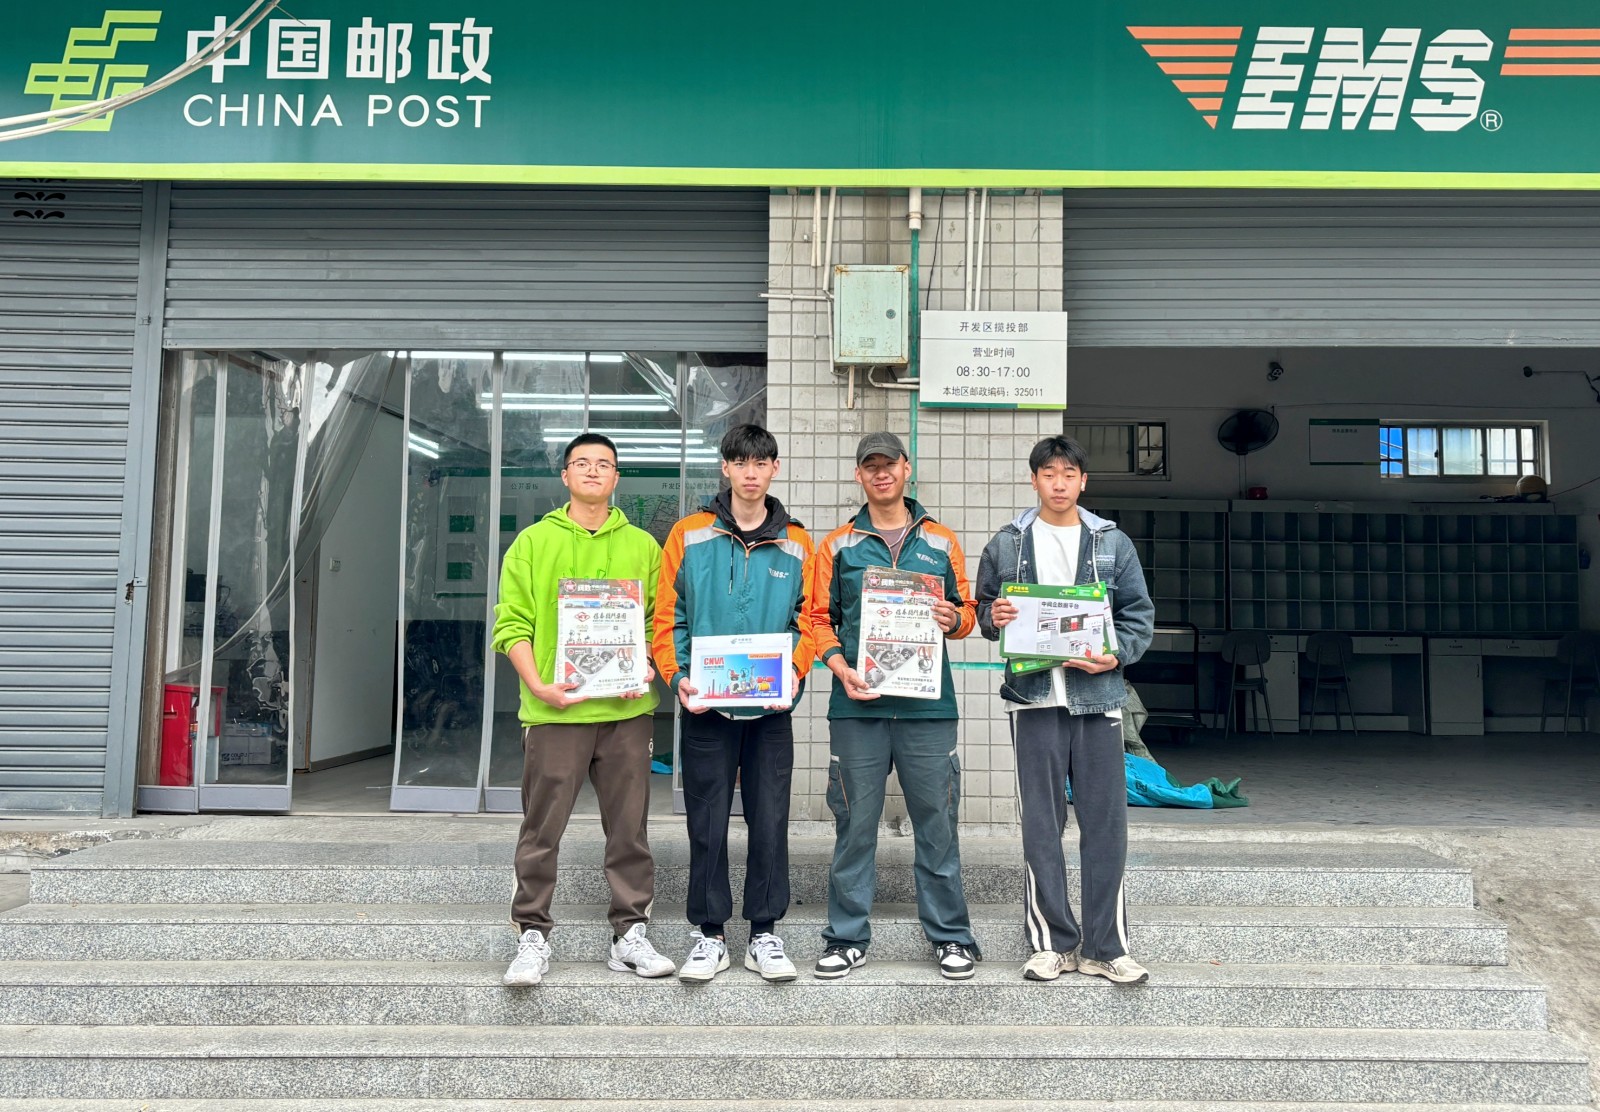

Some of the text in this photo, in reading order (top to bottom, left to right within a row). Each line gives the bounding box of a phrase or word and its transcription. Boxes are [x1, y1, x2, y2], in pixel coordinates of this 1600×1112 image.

[186, 16, 493, 84] 中国邮政
[1232, 26, 1494, 131] EMS
[183, 94, 491, 128] CHINA POST
[959, 322, 1029, 333] 开发区揽投部
[972, 347, 1015, 358] 营业时间
[956, 366, 1030, 378] 08:30-17:00
